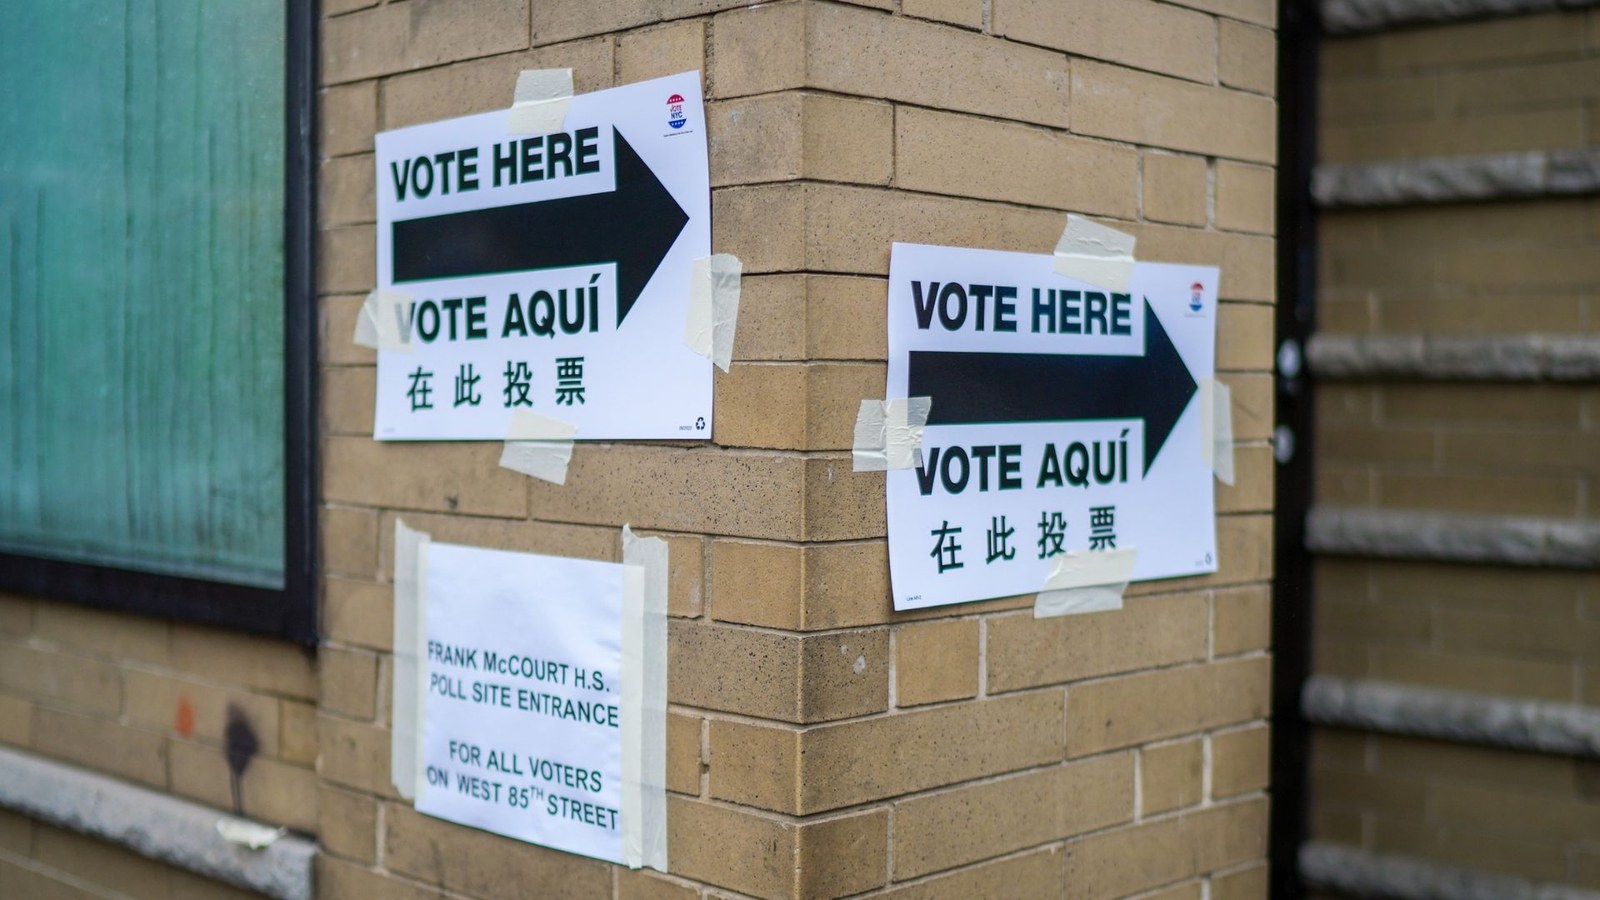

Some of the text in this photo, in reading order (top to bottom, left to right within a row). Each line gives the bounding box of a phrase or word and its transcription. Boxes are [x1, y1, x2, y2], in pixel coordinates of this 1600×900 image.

[390, 126, 600, 202] VOTE HERE
[395, 273, 602, 344] VOTE AQUÍ
[911, 280, 1132, 336] VOTE HERE
[406, 356, 586, 413] 在此投票
[915, 428, 1131, 496] VOTE AQUÍ
[930, 505, 1117, 574] 在此投票
[428, 641, 611, 693] FRANK McCOURT H.S.
[430, 672, 620, 728] POLL SITE ENTRANCE
[449, 740, 603, 794] FOR ALL VOTERS
[427, 765, 619, 831] ON WEST 85TH STREET
